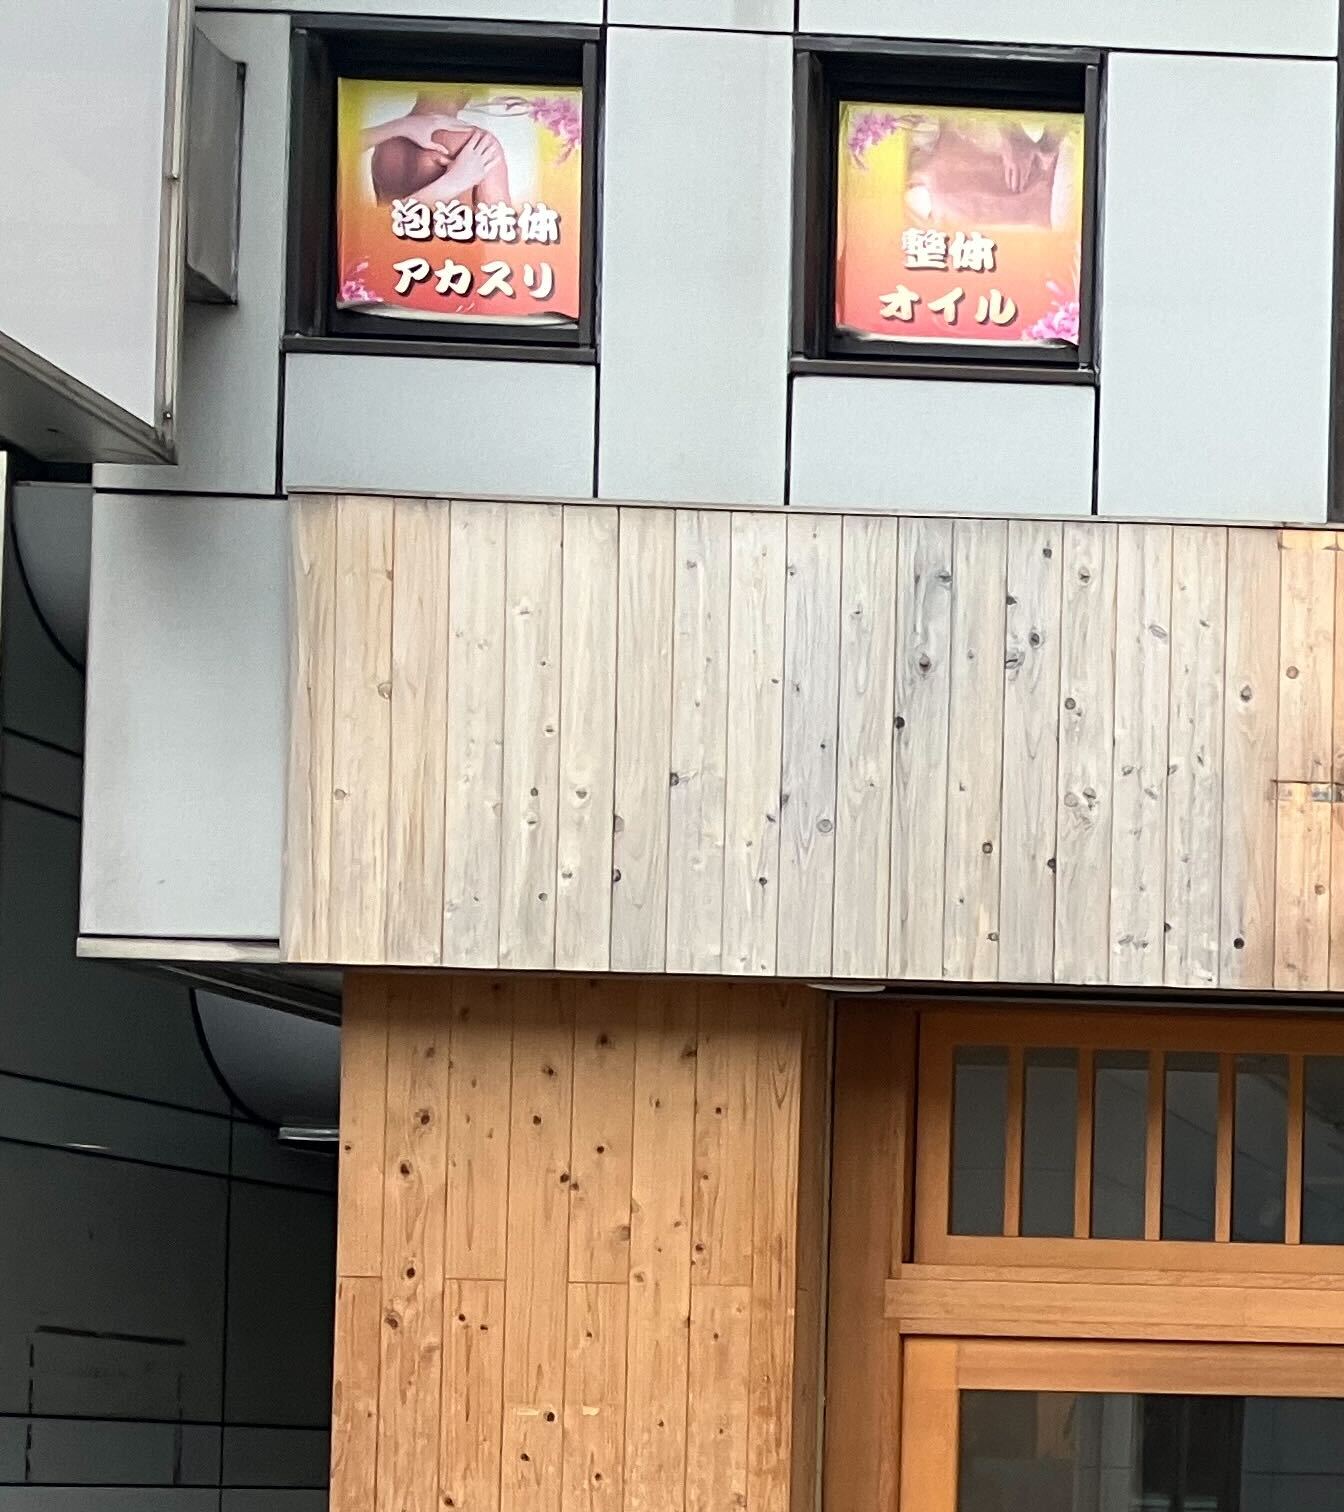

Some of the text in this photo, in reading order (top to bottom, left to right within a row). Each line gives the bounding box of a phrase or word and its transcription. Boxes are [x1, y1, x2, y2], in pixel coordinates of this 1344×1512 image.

[391, 198, 559, 242] 泡泡洗体
[901, 228, 996, 271] 整体
[393, 258, 554, 298] アカスリ
[879, 284, 1017, 325] オイル
